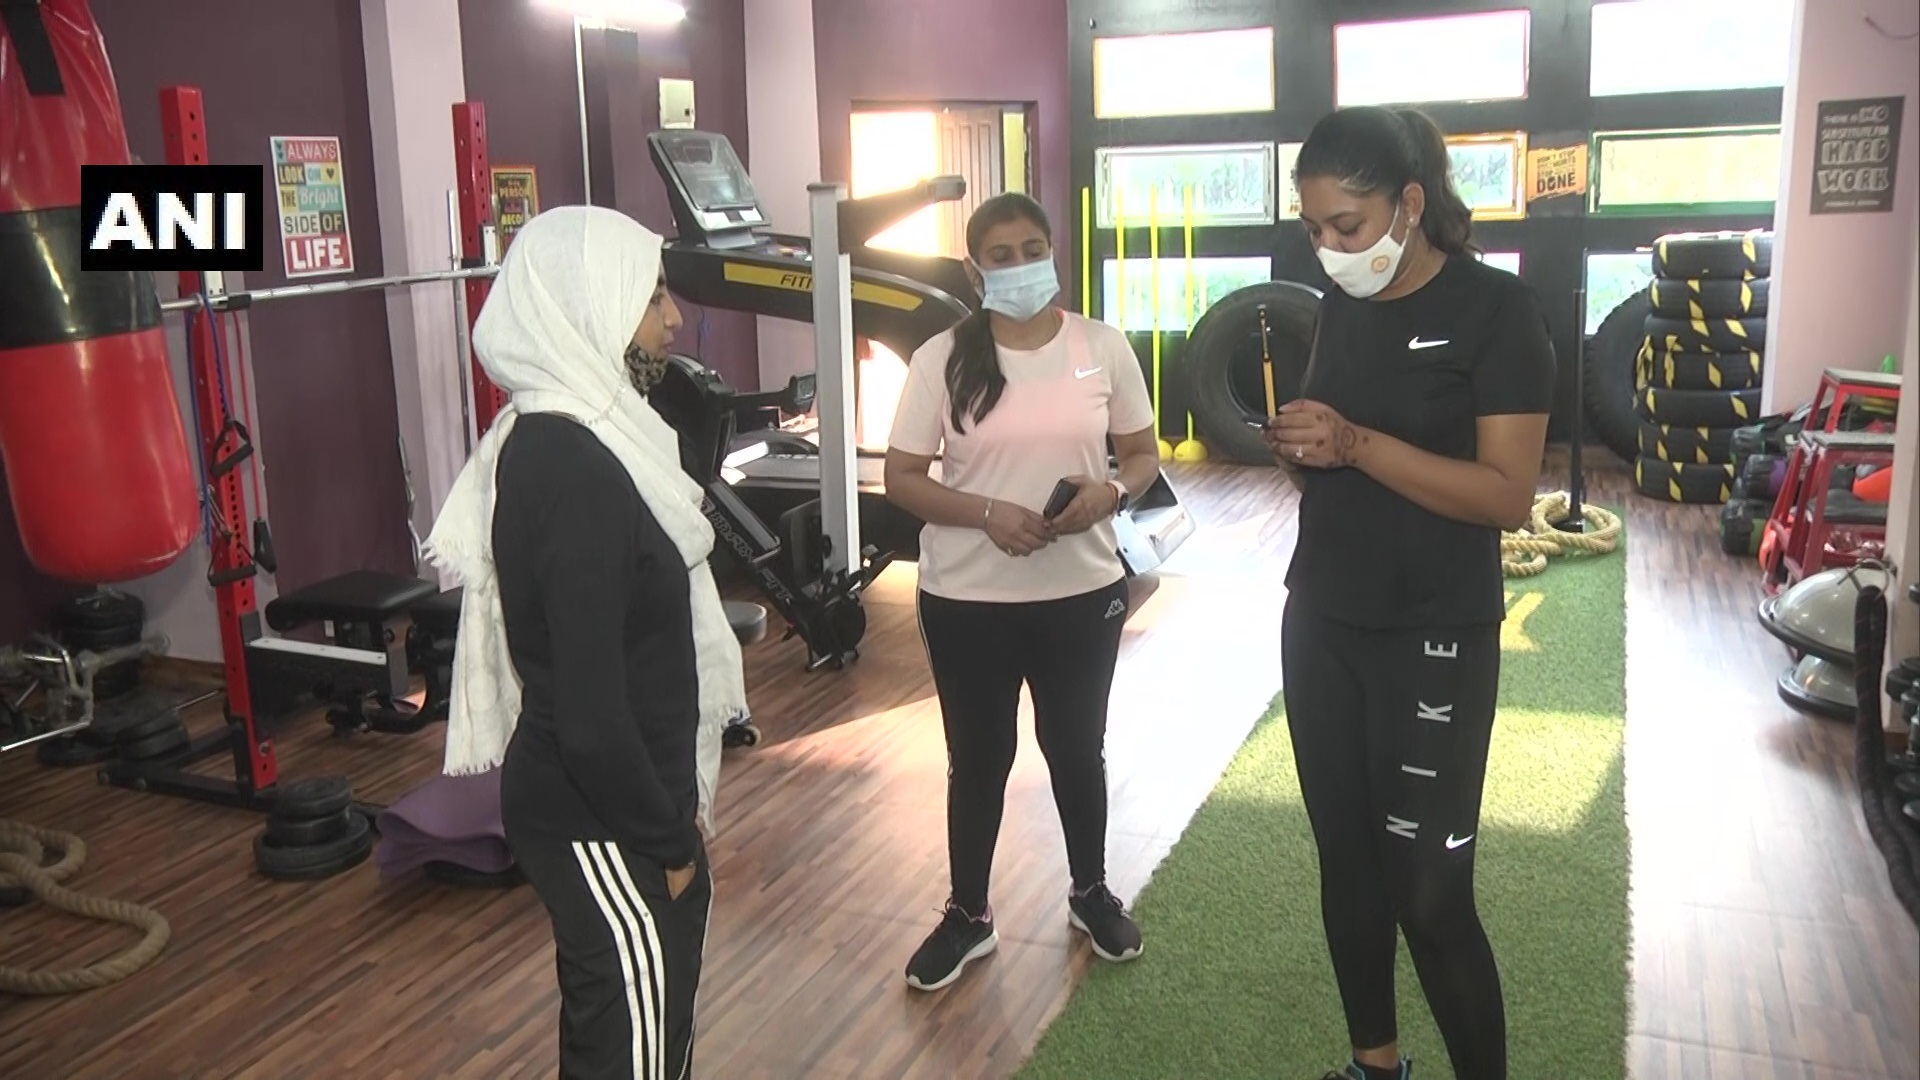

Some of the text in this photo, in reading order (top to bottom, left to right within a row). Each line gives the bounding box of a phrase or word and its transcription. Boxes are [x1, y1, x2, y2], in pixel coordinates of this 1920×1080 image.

[287, 142, 337, 159] ALWAYS
[1821, 138, 1890, 165] HARD
[279, 165, 304, 183] LOOK
[1537, 172, 1576, 193] DONE
[1816, 167, 1889, 193] WORK
[281, 188, 339, 209] THE Bright
[284, 214, 342, 234] SIDE OF
[291, 238, 344, 269] LIFE
[1386, 640, 1458, 839] NIKE
